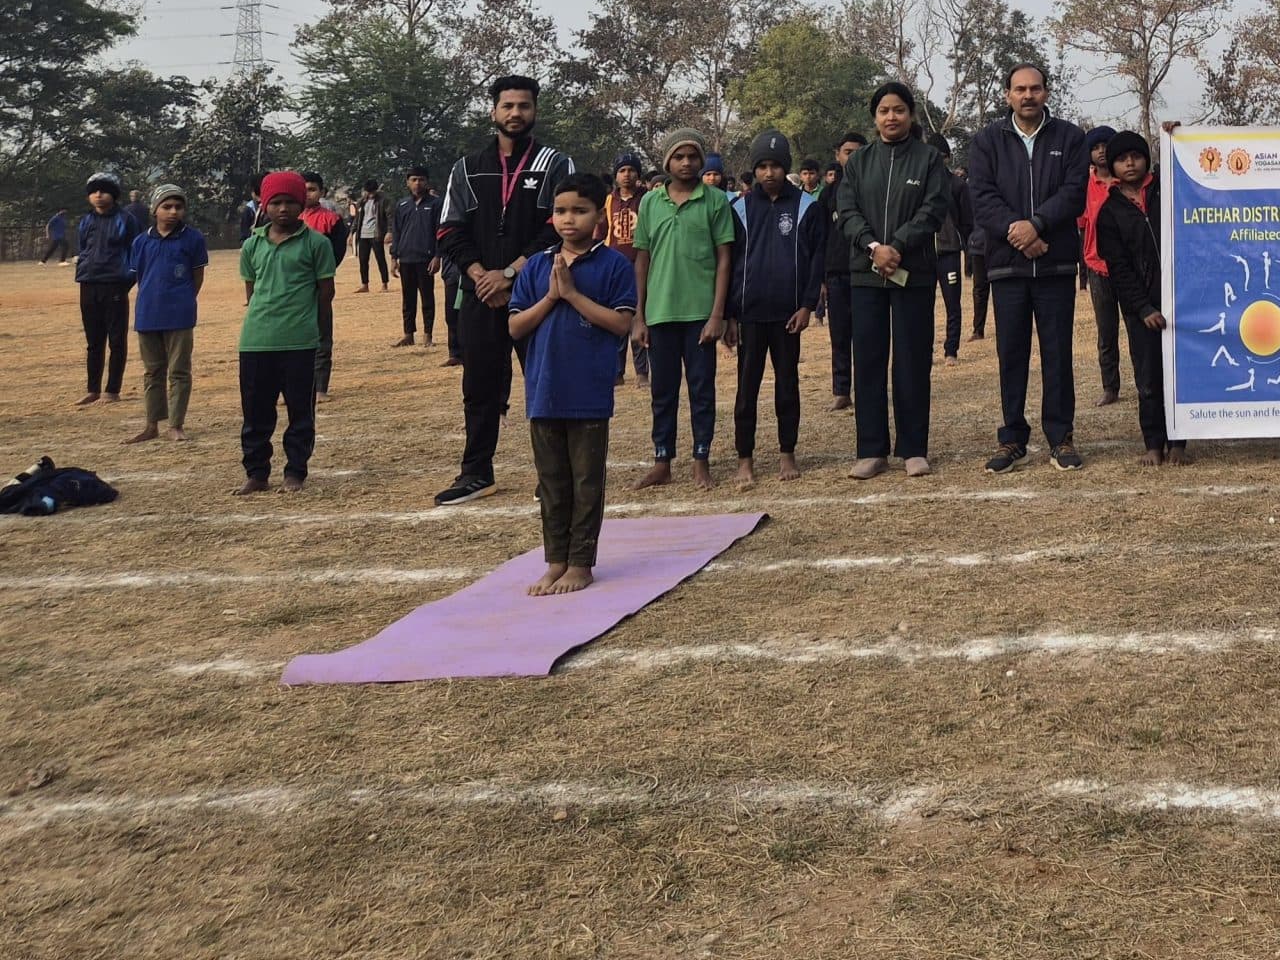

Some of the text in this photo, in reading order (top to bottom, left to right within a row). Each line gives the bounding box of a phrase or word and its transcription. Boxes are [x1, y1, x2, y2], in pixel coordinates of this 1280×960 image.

[1183, 207, 1241, 224] LATEHAR
[1189, 409, 1217, 420] Salute
[1218, 408, 1234, 419] the
[1235, 410, 1251, 418] sun
[1253, 407, 1270, 418] and
